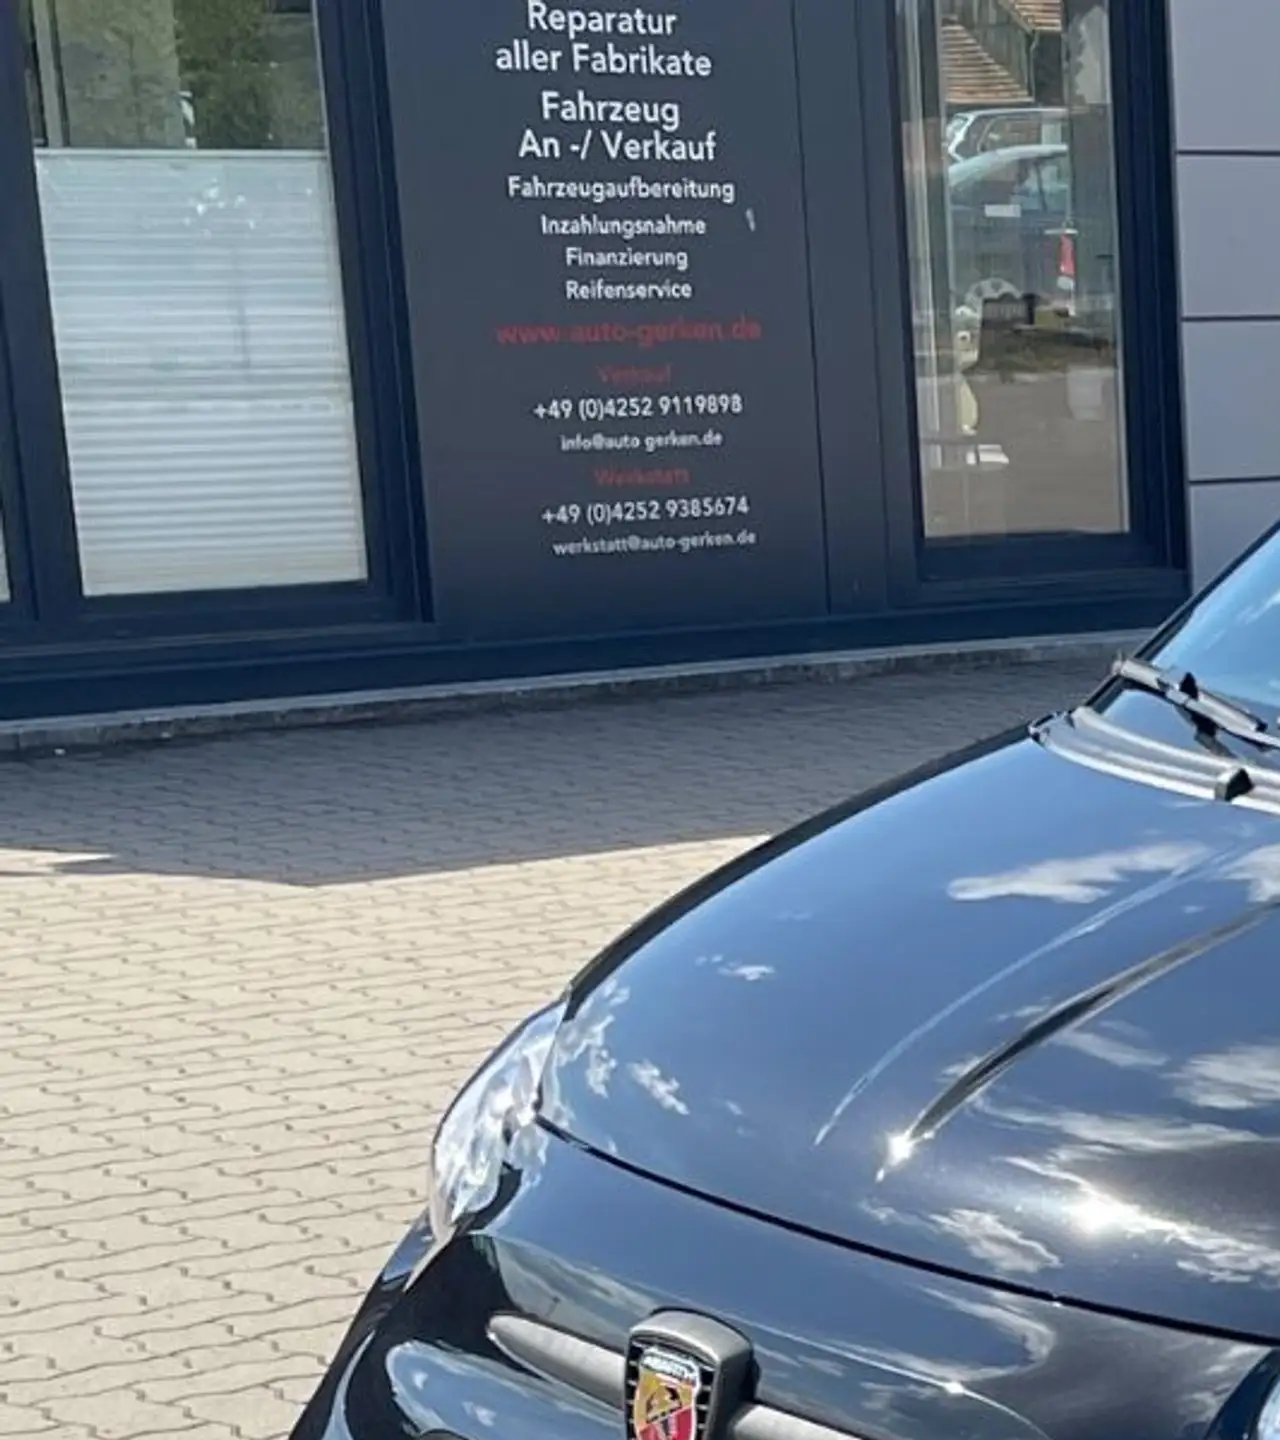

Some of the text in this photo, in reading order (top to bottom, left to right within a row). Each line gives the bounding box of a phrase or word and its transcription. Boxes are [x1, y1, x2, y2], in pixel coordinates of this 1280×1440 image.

[527, 0, 676, 39] Reparatur
[496, 39, 712, 76] aller Fabrikate
[541, 90, 680, 131] Fahrzeug
[519, 129, 560, 158] An
[600, 130, 717, 161] Verkauf
[508, 175, 735, 203] Fahrzeugaufbereitung
[541, 214, 706, 239] Inzahlungsnahme
[566, 247, 688, 270] Finanzierung
[566, 278, 692, 299] Reifenservice
[534, 394, 742, 421] +49 (0)4252 9119898
[561, 429, 723, 452] info@autogerken.de
[542, 496, 750, 525] +49 (0)4252 9385674
